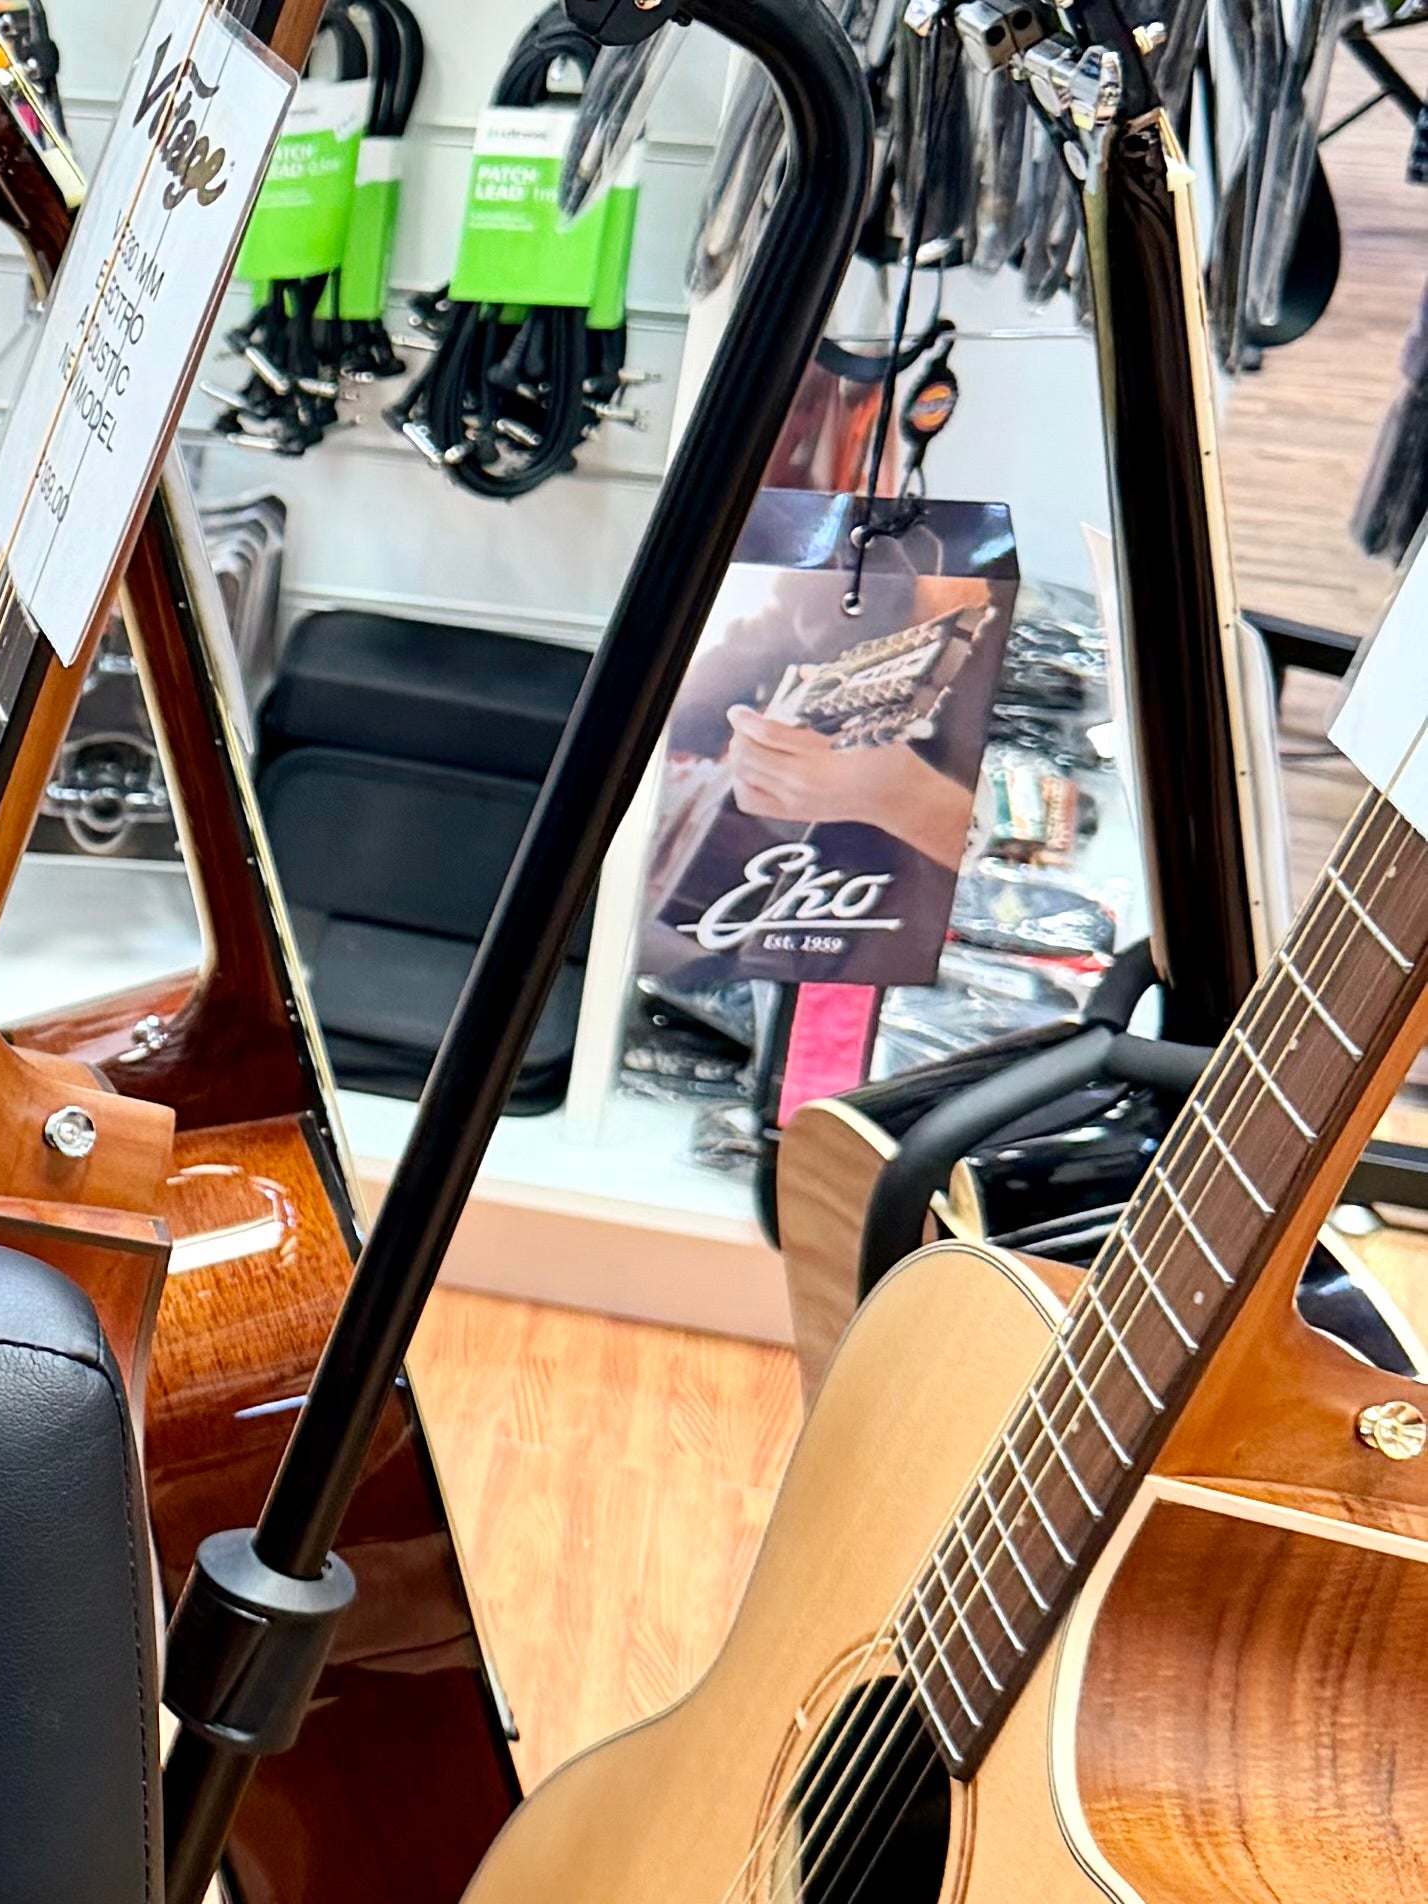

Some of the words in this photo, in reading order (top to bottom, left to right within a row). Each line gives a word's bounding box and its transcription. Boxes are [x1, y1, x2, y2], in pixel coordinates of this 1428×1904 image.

[133, 247, 166, 307] MM
[71, 369, 122, 463] MODEL
[696, 842, 894, 951] Eko
[762, 934, 794, 951] Est.
[800, 934, 844, 953] 1959
